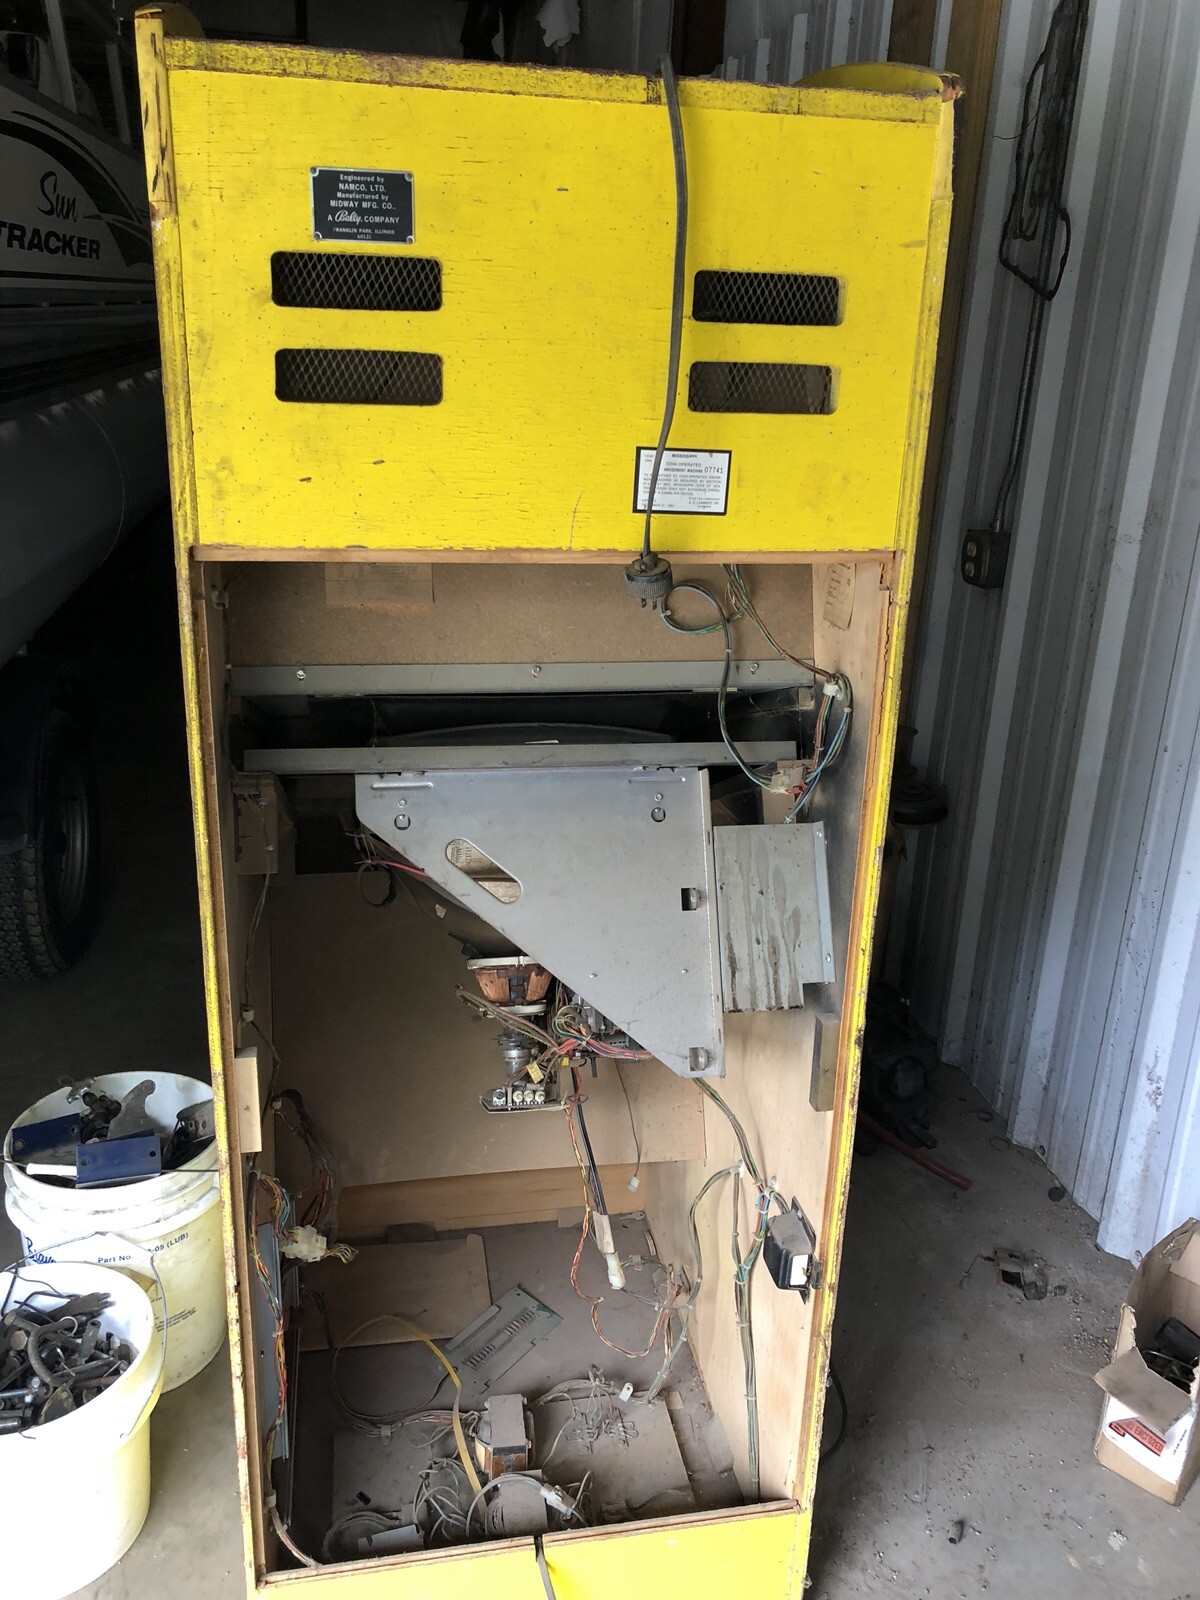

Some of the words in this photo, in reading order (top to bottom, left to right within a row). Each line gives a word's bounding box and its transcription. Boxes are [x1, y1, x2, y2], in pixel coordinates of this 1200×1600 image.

[339, 174, 375, 182] Engineered
[370, 184, 386, 192] LTD.
[37, 171, 77, 222] Sun
[336, 192, 379, 200] Manufactured
[329, 200, 359, 208] MIDWAY
[364, 215, 400, 223] COMPANY
[704, 466, 723, 474] 07741
[97, 1256, 116, 1264] Part
[166, 1232, 189, 1248] (LUB)
